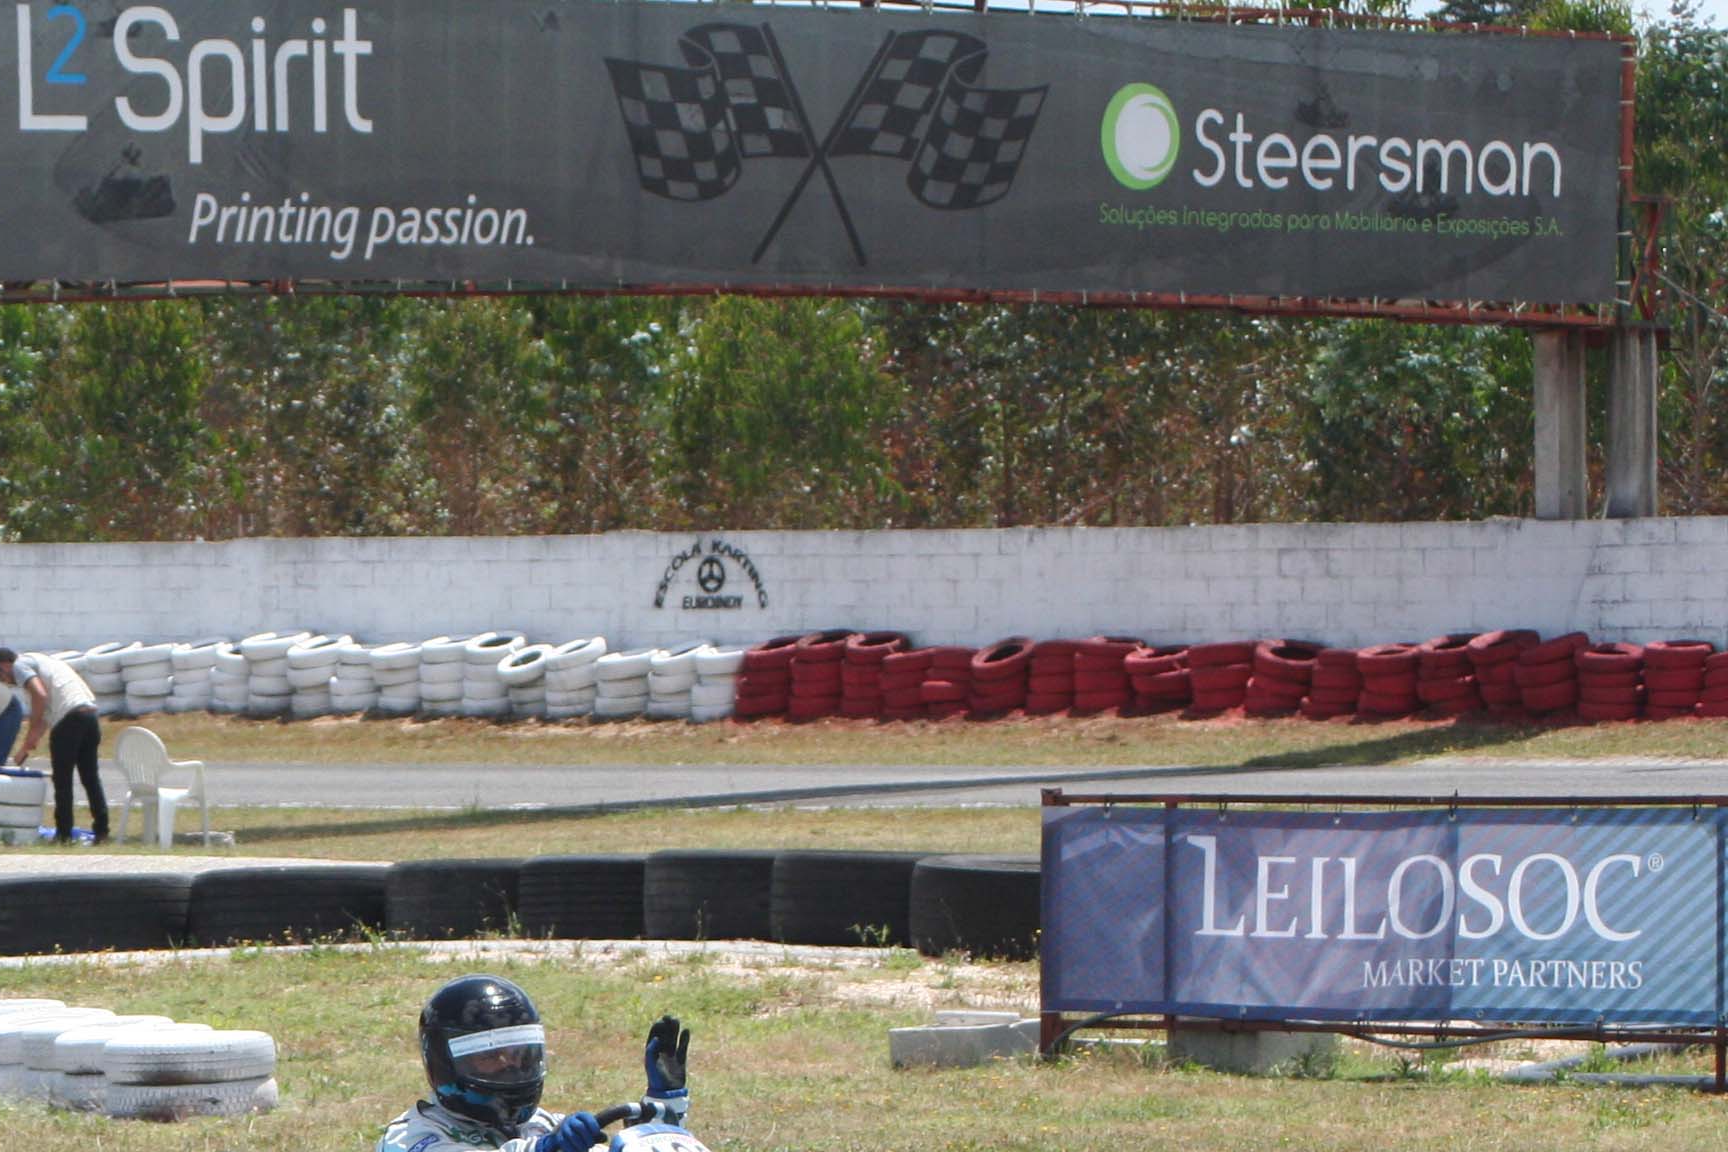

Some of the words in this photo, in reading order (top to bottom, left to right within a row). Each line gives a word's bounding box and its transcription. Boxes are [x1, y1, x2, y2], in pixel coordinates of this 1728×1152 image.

[113, 5, 374, 165] Spirit
[1192, 107, 1563, 198] Steersman
[189, 192, 361, 260] Printing
[364, 194, 536, 260] passion.
[1420, 217, 1433, 232] e
[1362, 958, 1485, 989] MARKET
[1492, 958, 1644, 990] PARTNERS
